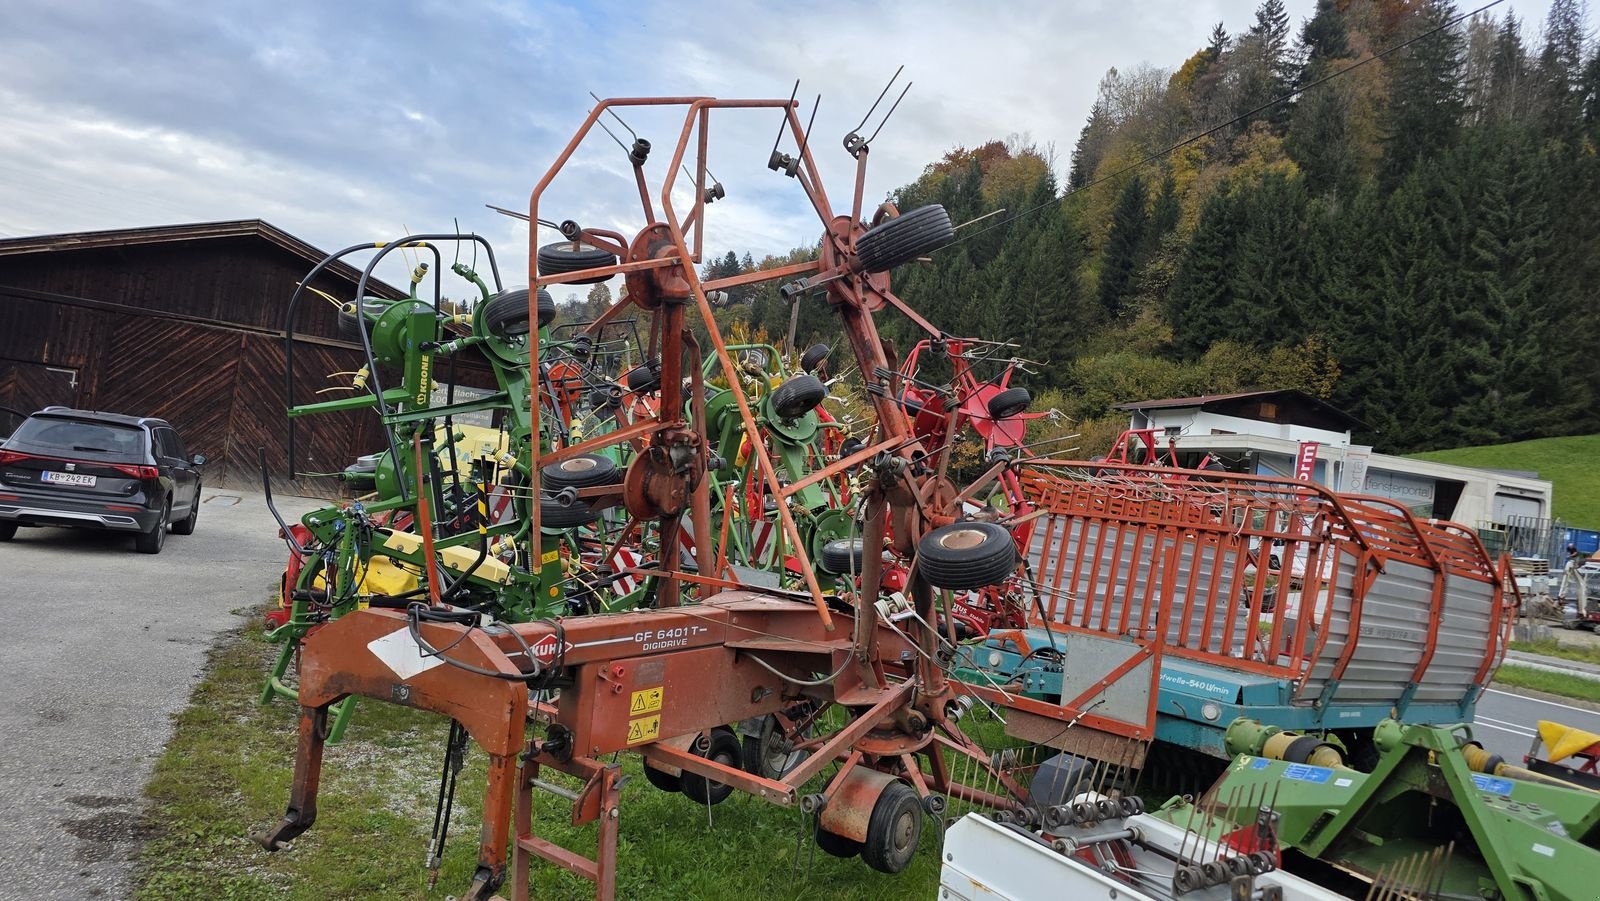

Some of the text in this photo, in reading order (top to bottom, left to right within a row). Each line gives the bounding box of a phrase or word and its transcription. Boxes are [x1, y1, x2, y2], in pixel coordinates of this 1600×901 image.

[420, 355, 429, 392] KRONE
[82, 476, 94, 484] EK
[634, 631, 653, 642] GF
[657, 627, 688, 640] 6401
[642, 638, 688, 651] DIGIDRIVE
